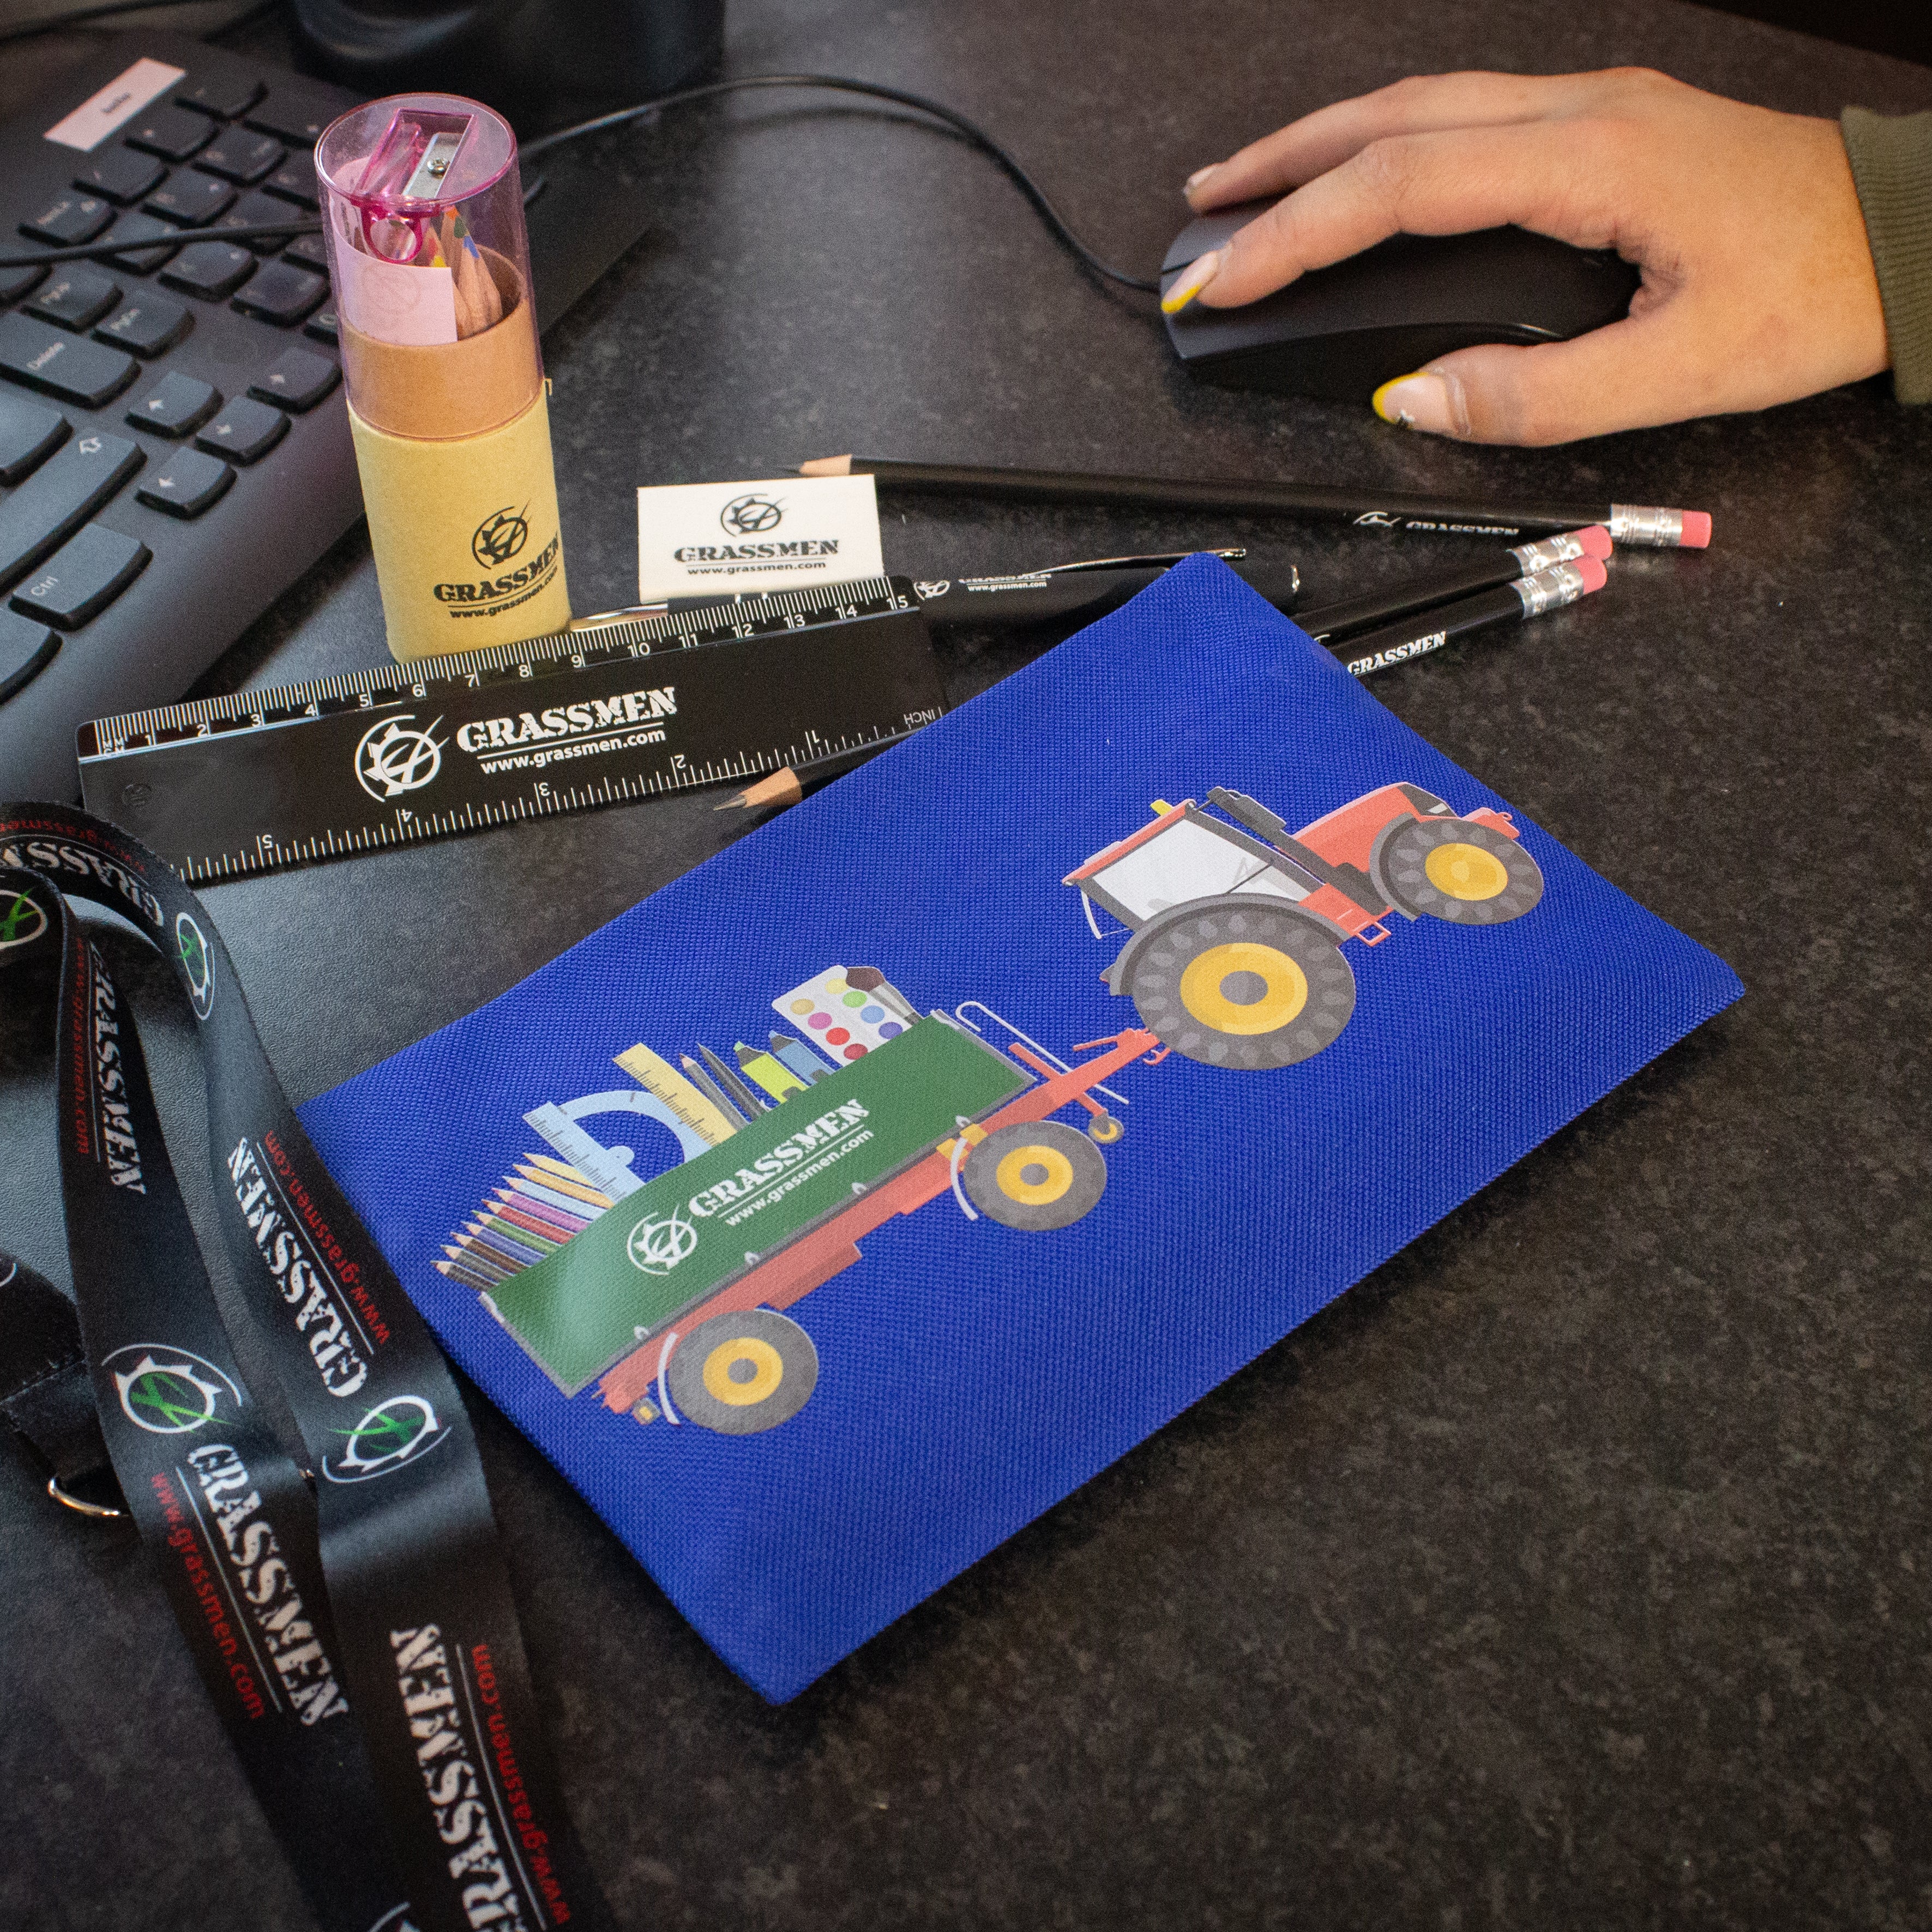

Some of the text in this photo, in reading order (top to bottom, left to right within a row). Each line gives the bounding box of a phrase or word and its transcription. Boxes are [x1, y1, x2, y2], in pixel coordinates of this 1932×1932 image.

[434, 531, 558, 602] GRASSMEN
[674, 539, 839, 562] GRASSMEN
[687, 560, 826, 575] www.grassmen.com
[145, 595, 908, 745] 1 2 3 4 5 6 7 8 9 10 11 12 13 14 15
[1347, 631, 1446, 675] GRASSMEN
[457, 686, 677, 752] GRASSMEN
[481, 729, 665, 774] www.grassmen.com
[904, 709, 935, 725] INCH
[262, 730, 820, 850] 1 2 3 4 5
[688, 1099, 869, 1218] GRASSMEN
[725, 1129, 874, 1227] www.grassmen.com
[227, 1137, 368, 1397] GRASSMEN
[264, 1130, 390, 1344] www.grassmen.com
[151, 1472, 265, 1718] www.grassmen.com
[186, 1444, 349, 1725] GRASSMEN
[390, 1624, 528, 1932] RASSMEN
[472, 1644, 570, 1924] www.grassmen.com
